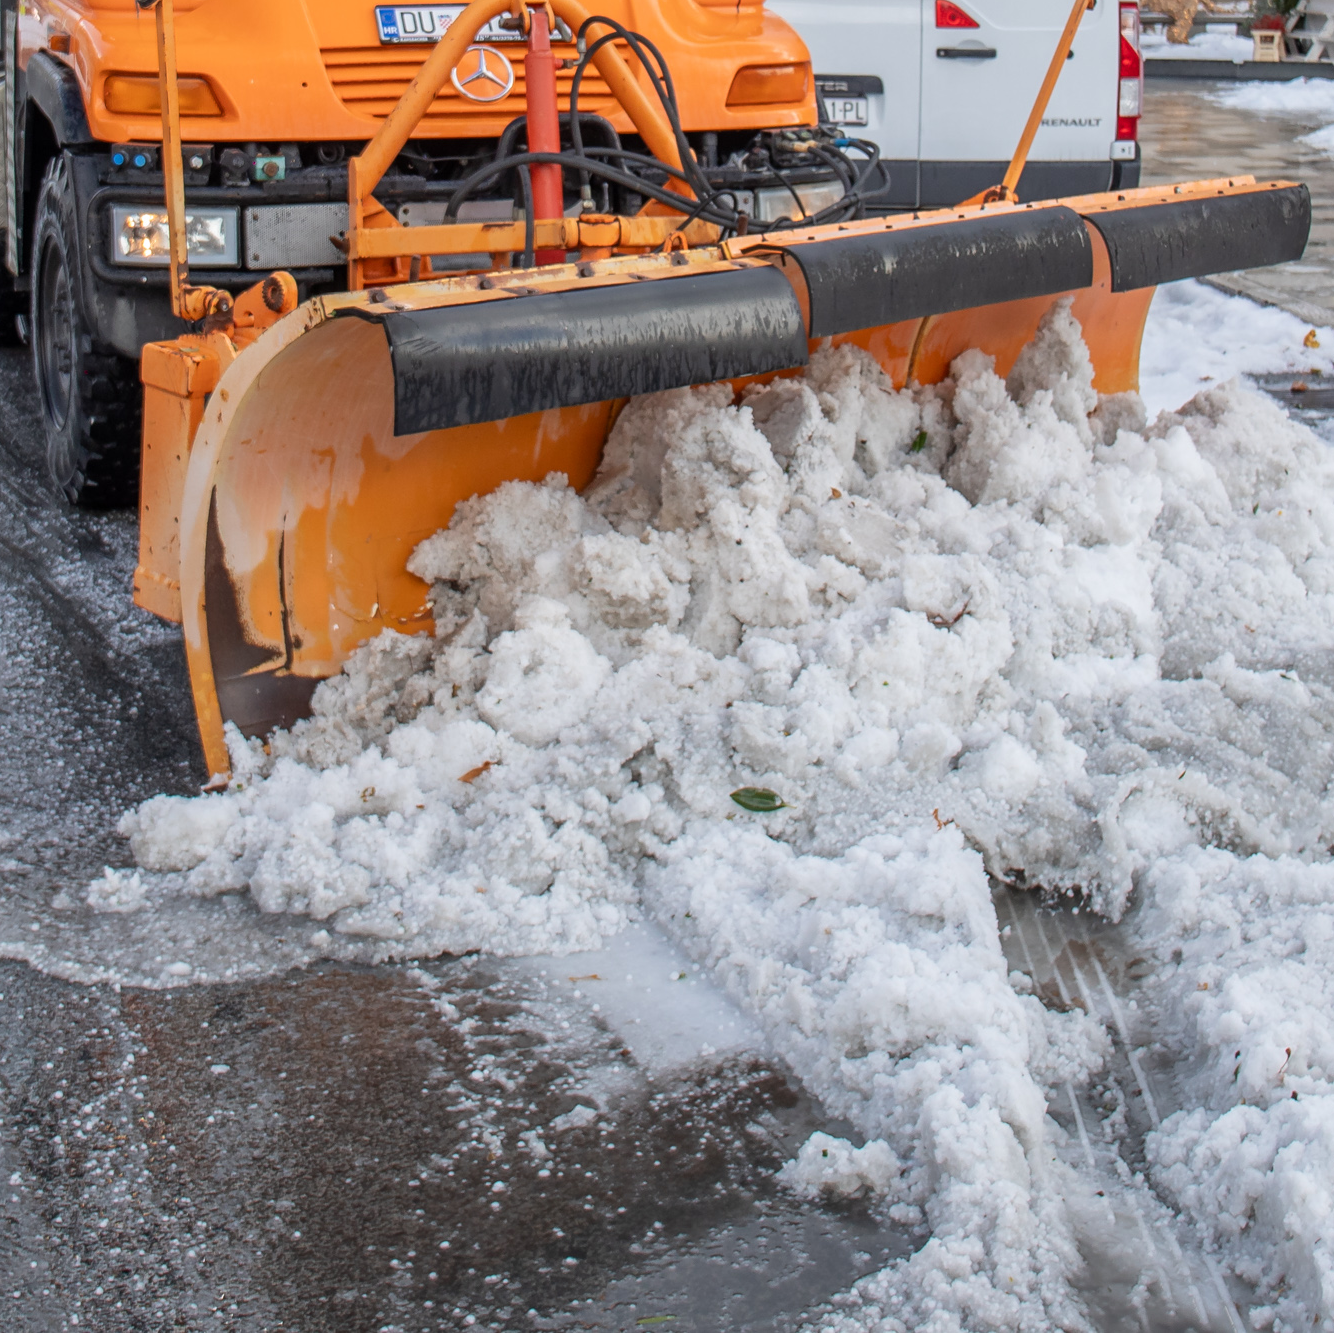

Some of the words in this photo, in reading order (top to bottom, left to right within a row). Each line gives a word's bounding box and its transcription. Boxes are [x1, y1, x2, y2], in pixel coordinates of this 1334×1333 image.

[400, 11, 436, 34] DU
[383, 26, 398, 34] HR
[1041, 118, 1102, 128] RENAULT
